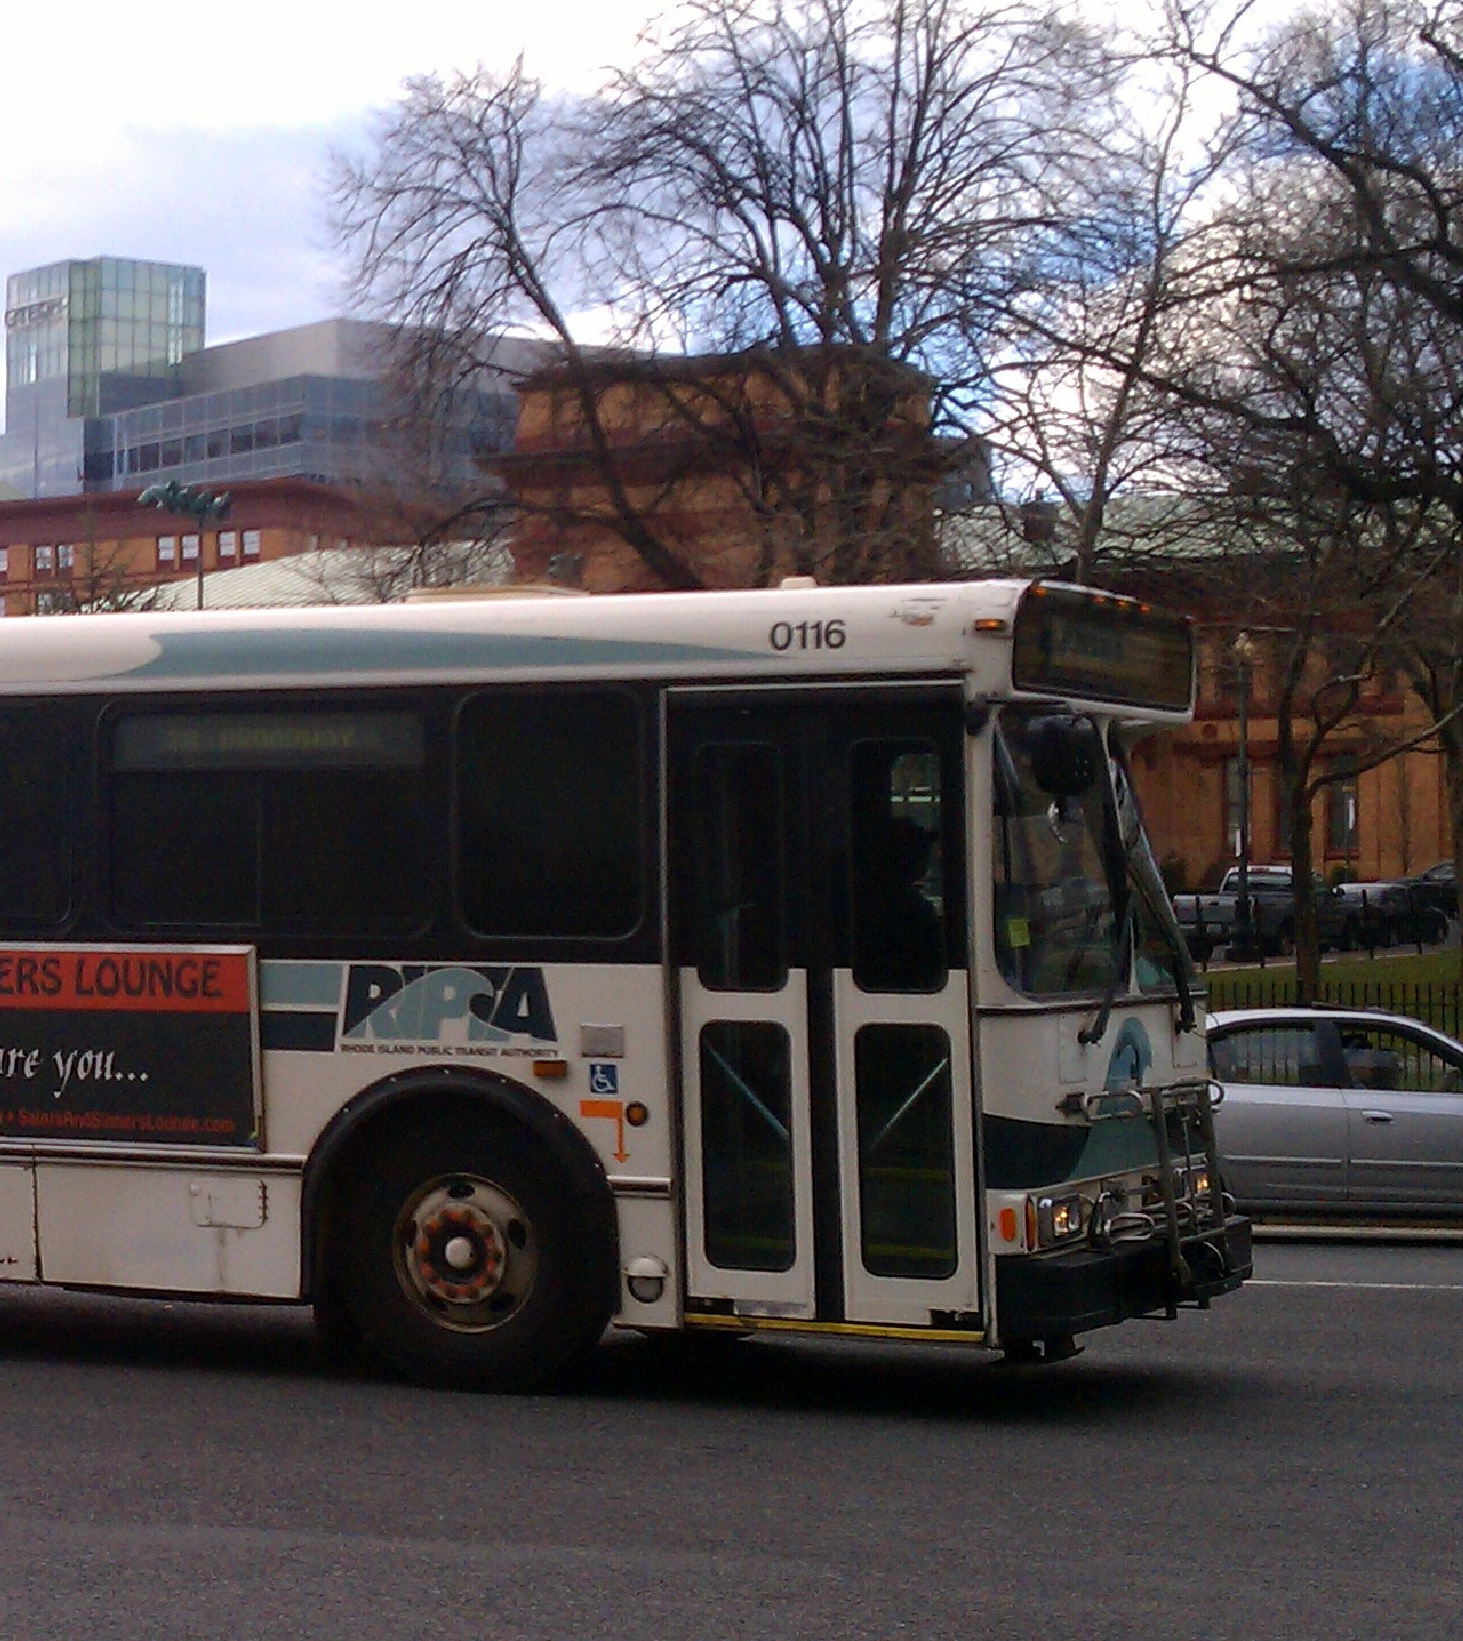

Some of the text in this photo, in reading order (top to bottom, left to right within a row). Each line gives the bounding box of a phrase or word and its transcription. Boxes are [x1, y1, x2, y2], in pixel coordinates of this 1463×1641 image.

[770, 620, 846, 651] 0116
[76, 958, 223, 998] LOUNGE
[53, 1049, 149, 1099] you...
